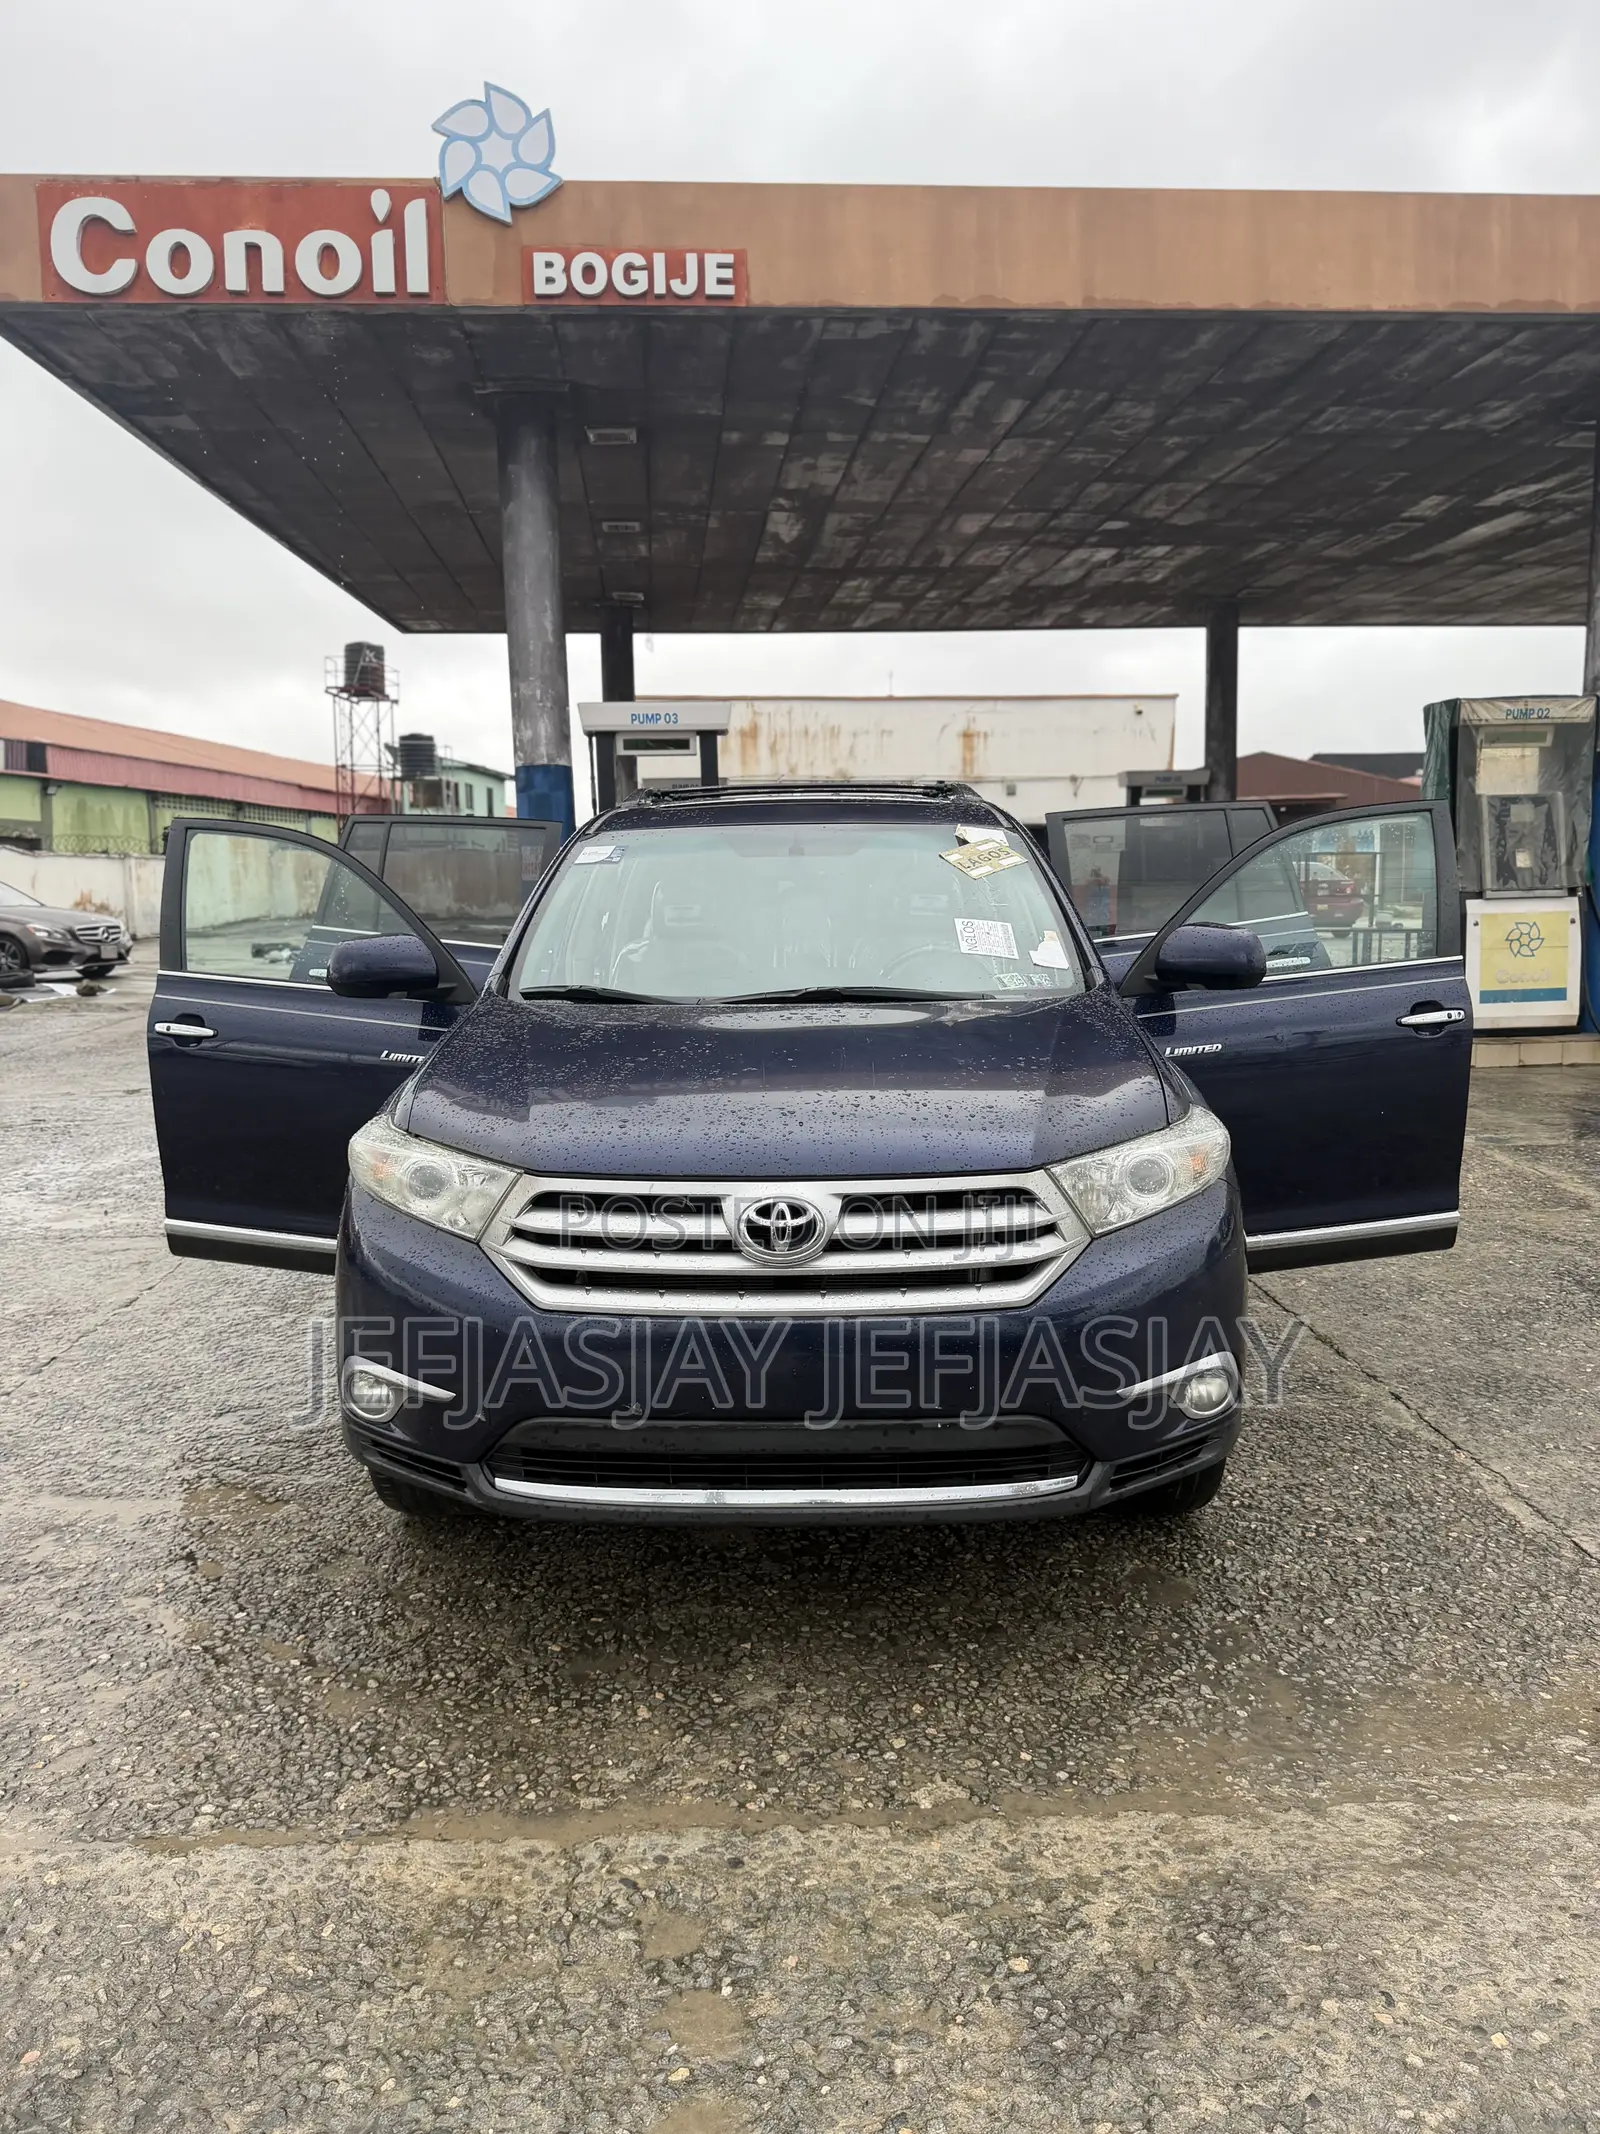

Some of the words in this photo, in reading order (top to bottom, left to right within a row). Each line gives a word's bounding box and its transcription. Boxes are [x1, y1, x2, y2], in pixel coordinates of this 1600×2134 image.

[50, 188, 431, 297] Conoil
[532, 251, 737, 299] BOGIJE
[630, 713, 662, 725] PUMP
[664, 712, 679, 724] 03
[1505, 708, 1535, 720] PUMP
[1536, 707, 1551, 719] 02
[957, 847, 1011, 870] LAGOS
[962, 920, 979, 952] NGLOS
[1164, 1043, 1223, 1058] LIMITED
